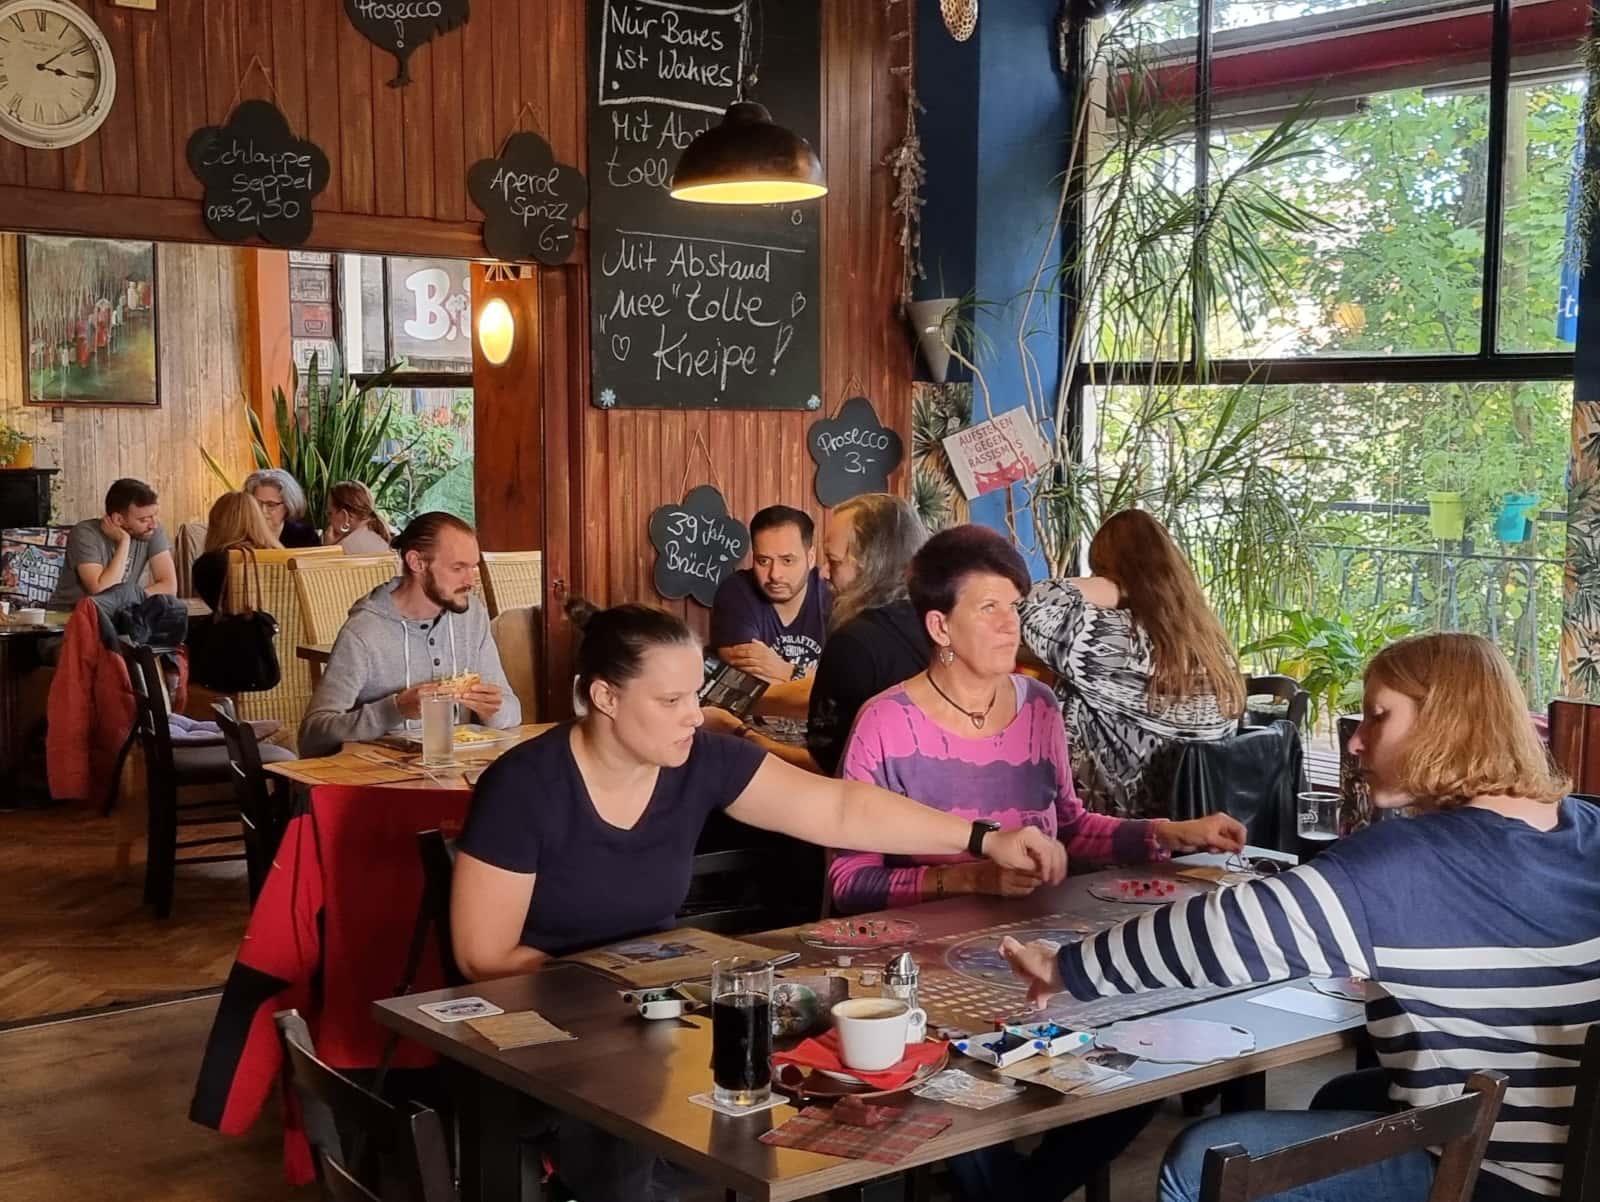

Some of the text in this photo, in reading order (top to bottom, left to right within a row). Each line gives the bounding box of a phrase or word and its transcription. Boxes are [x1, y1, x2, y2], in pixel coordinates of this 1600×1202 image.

[661, 11, 724, 51] Bares
[616, 45, 649, 71] ist
[611, 110, 653, 142] Mit
[490, 167, 560, 201] Aperol
[235, 197, 300, 225] 2,50
[602, 237, 657, 277] Mit
[653, 323, 757, 391] Kneipe
[817, 427, 889, 457] Prosecco
[667, 512, 742, 559] 39 Jahre
